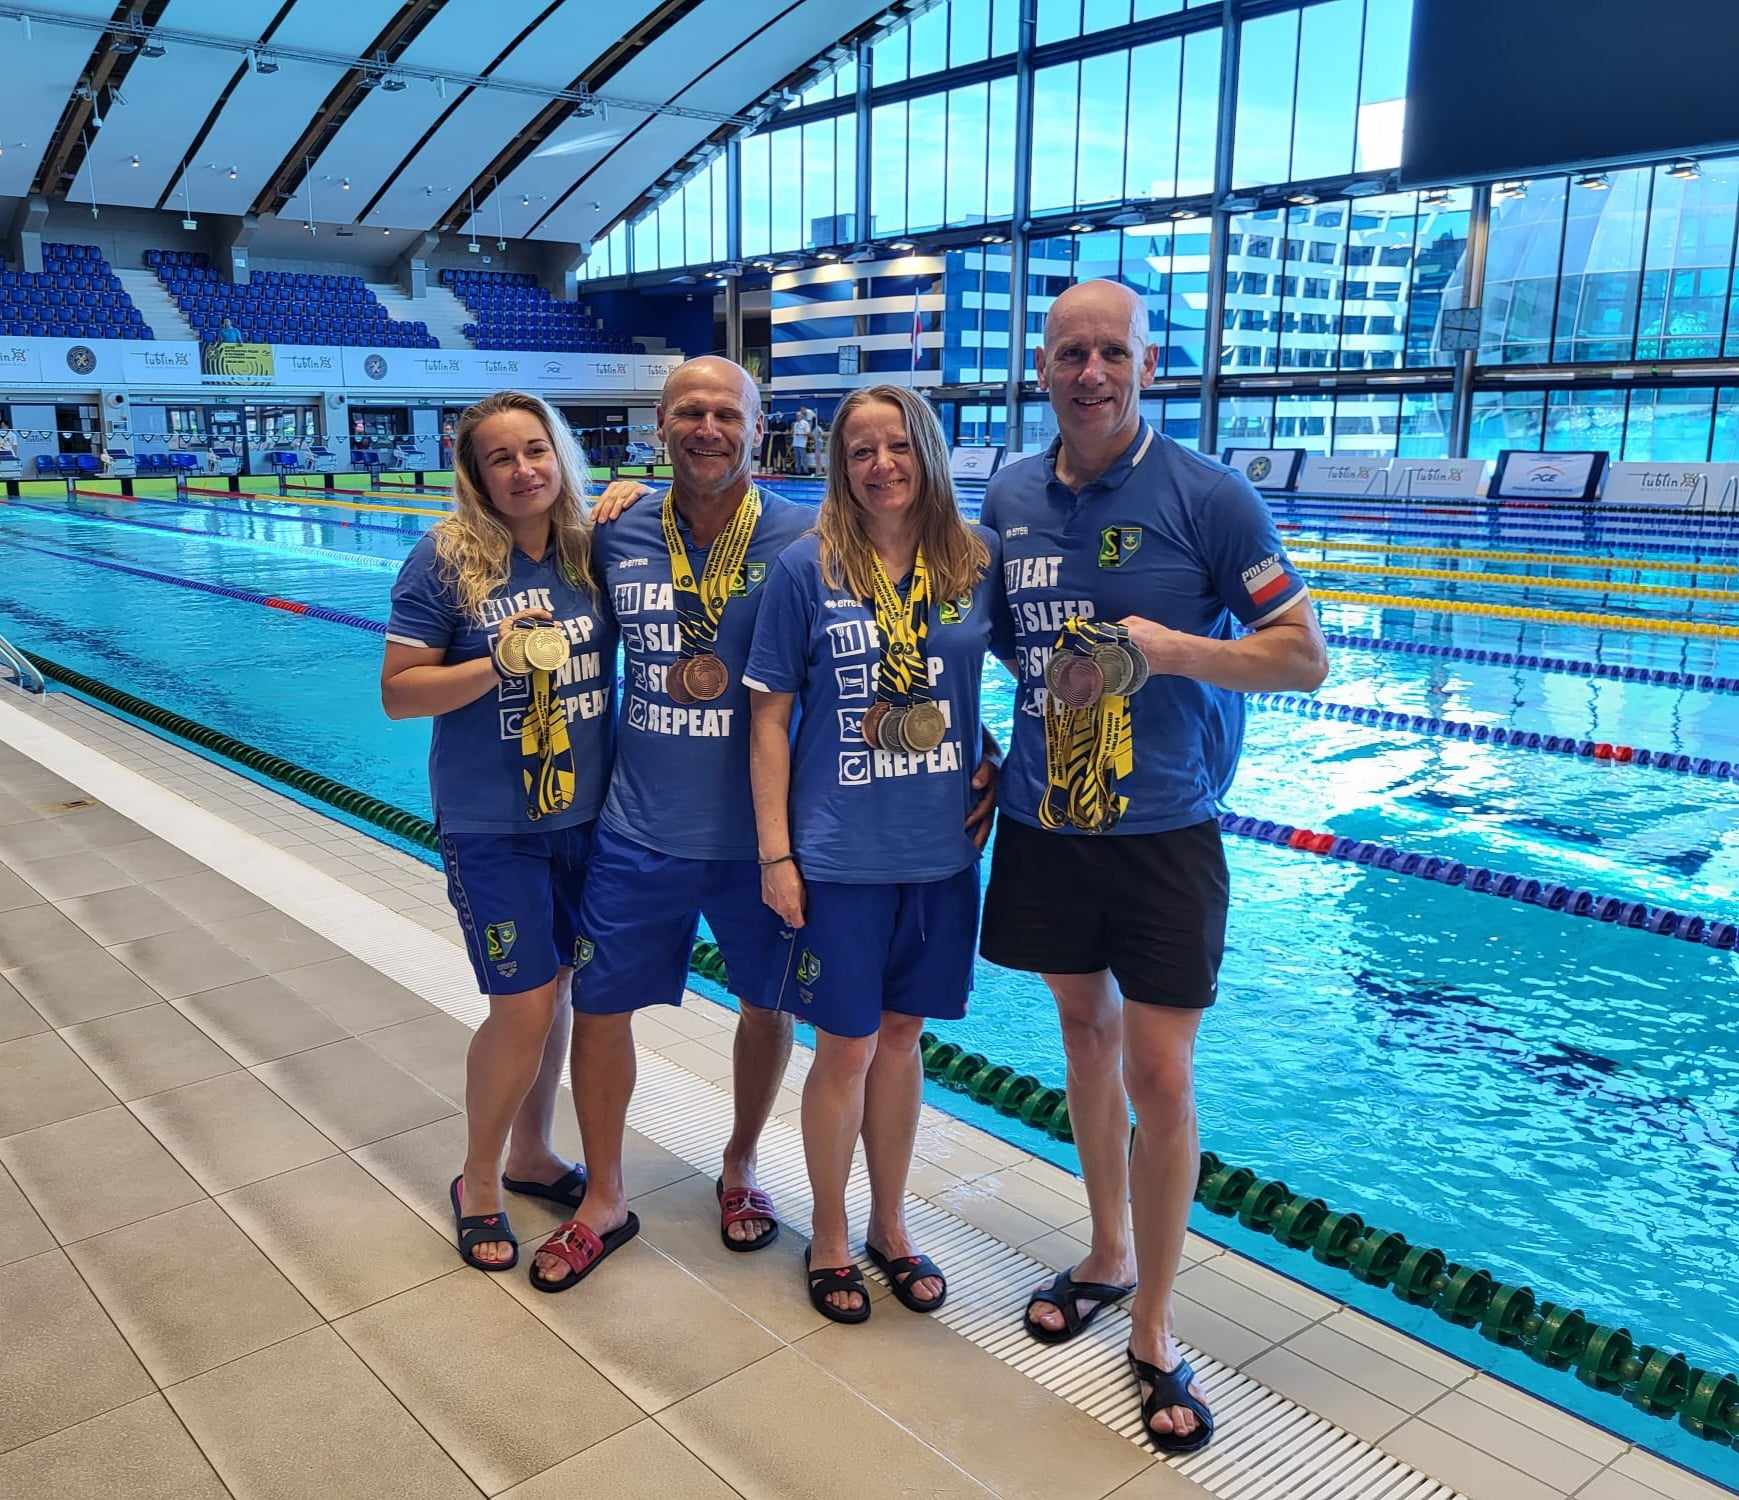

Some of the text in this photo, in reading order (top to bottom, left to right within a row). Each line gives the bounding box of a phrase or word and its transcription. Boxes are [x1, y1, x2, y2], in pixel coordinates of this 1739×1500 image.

[1021, 556, 1064, 589] EAT
[513, 588, 555, 612] EAT
[644, 583, 675, 611] EA
[553, 652, 601, 690] WIM
[647, 703, 735, 737] REPEAT
